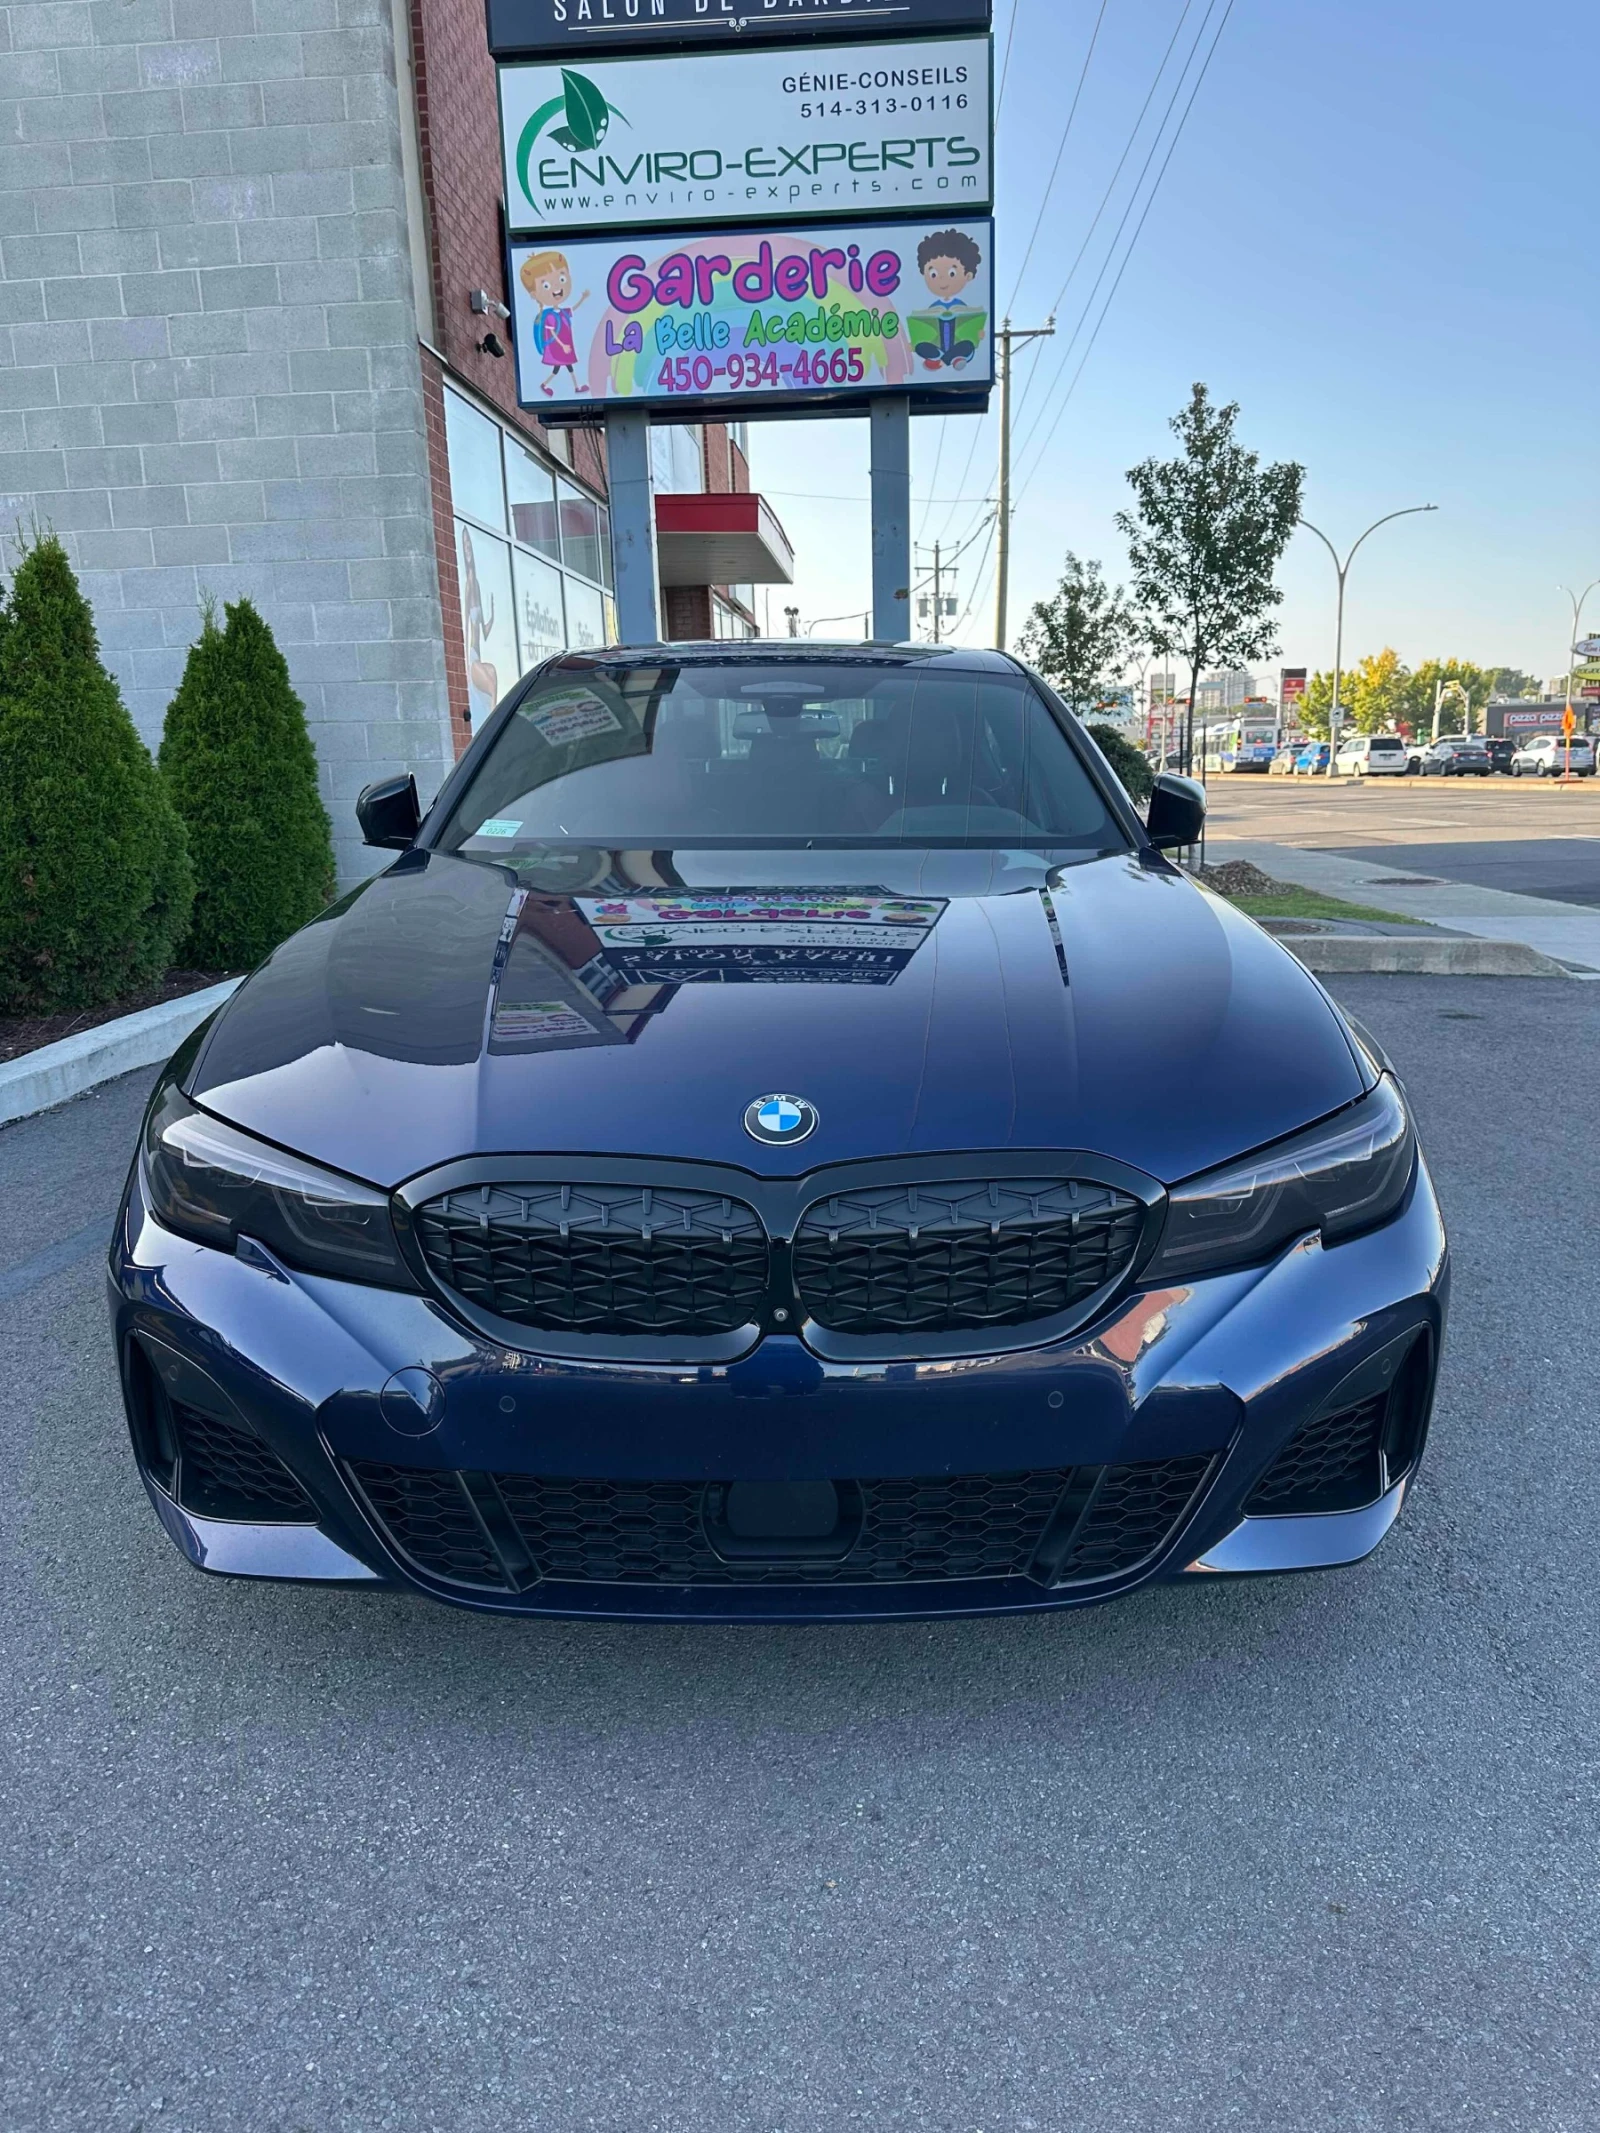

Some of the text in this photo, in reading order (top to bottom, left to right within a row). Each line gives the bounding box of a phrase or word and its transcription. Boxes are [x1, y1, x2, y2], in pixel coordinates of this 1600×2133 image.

[554, 0, 665, 21] SALON
[782, 66, 969, 94] GÉNIE-CONSEILS
[800, 94, 969, 119] 514-313-0116
[539, 135, 981, 190] ENVIRO-EXPERTS
[544, 173, 978, 210] www.enviro-experts.com
[606, 240, 902, 314] Garderie
[605, 303, 899, 357] La Belle Académie
[657, 347, 865, 392] 450-934-4665
[752, 1095, 809, 1109] BMW
